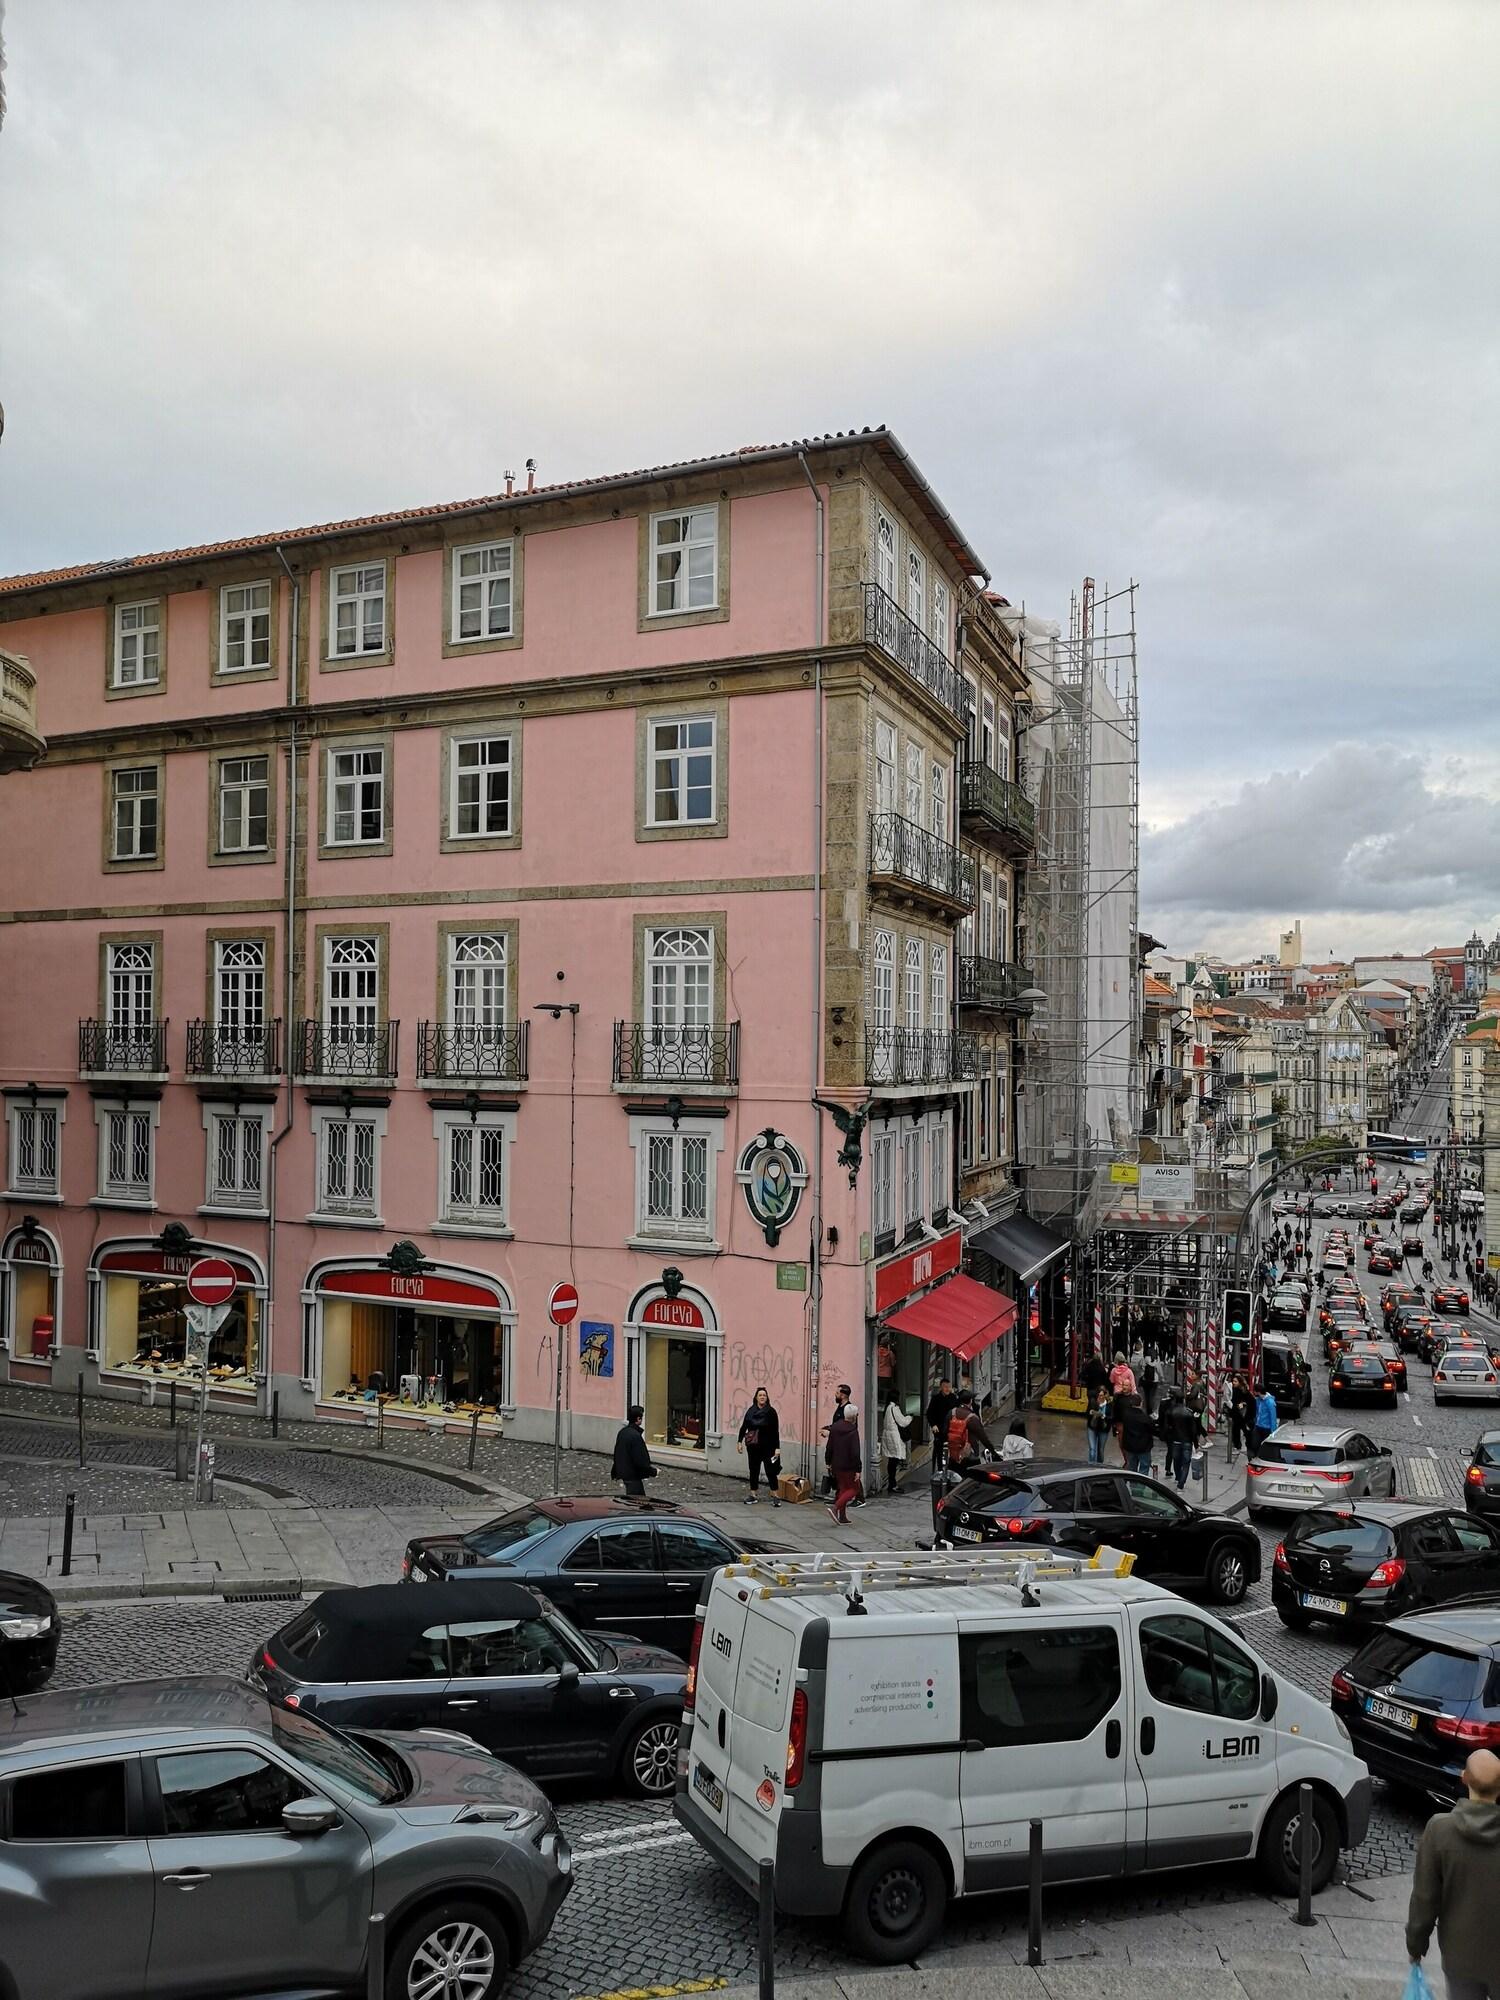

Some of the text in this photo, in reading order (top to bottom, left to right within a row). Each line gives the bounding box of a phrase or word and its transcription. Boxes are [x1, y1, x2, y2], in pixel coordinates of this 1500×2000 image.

[1155, 1168, 1180, 1176] AVISO
[711, 1627, 732, 1658] LBM
[1205, 1735, 1260, 1759] LBM
